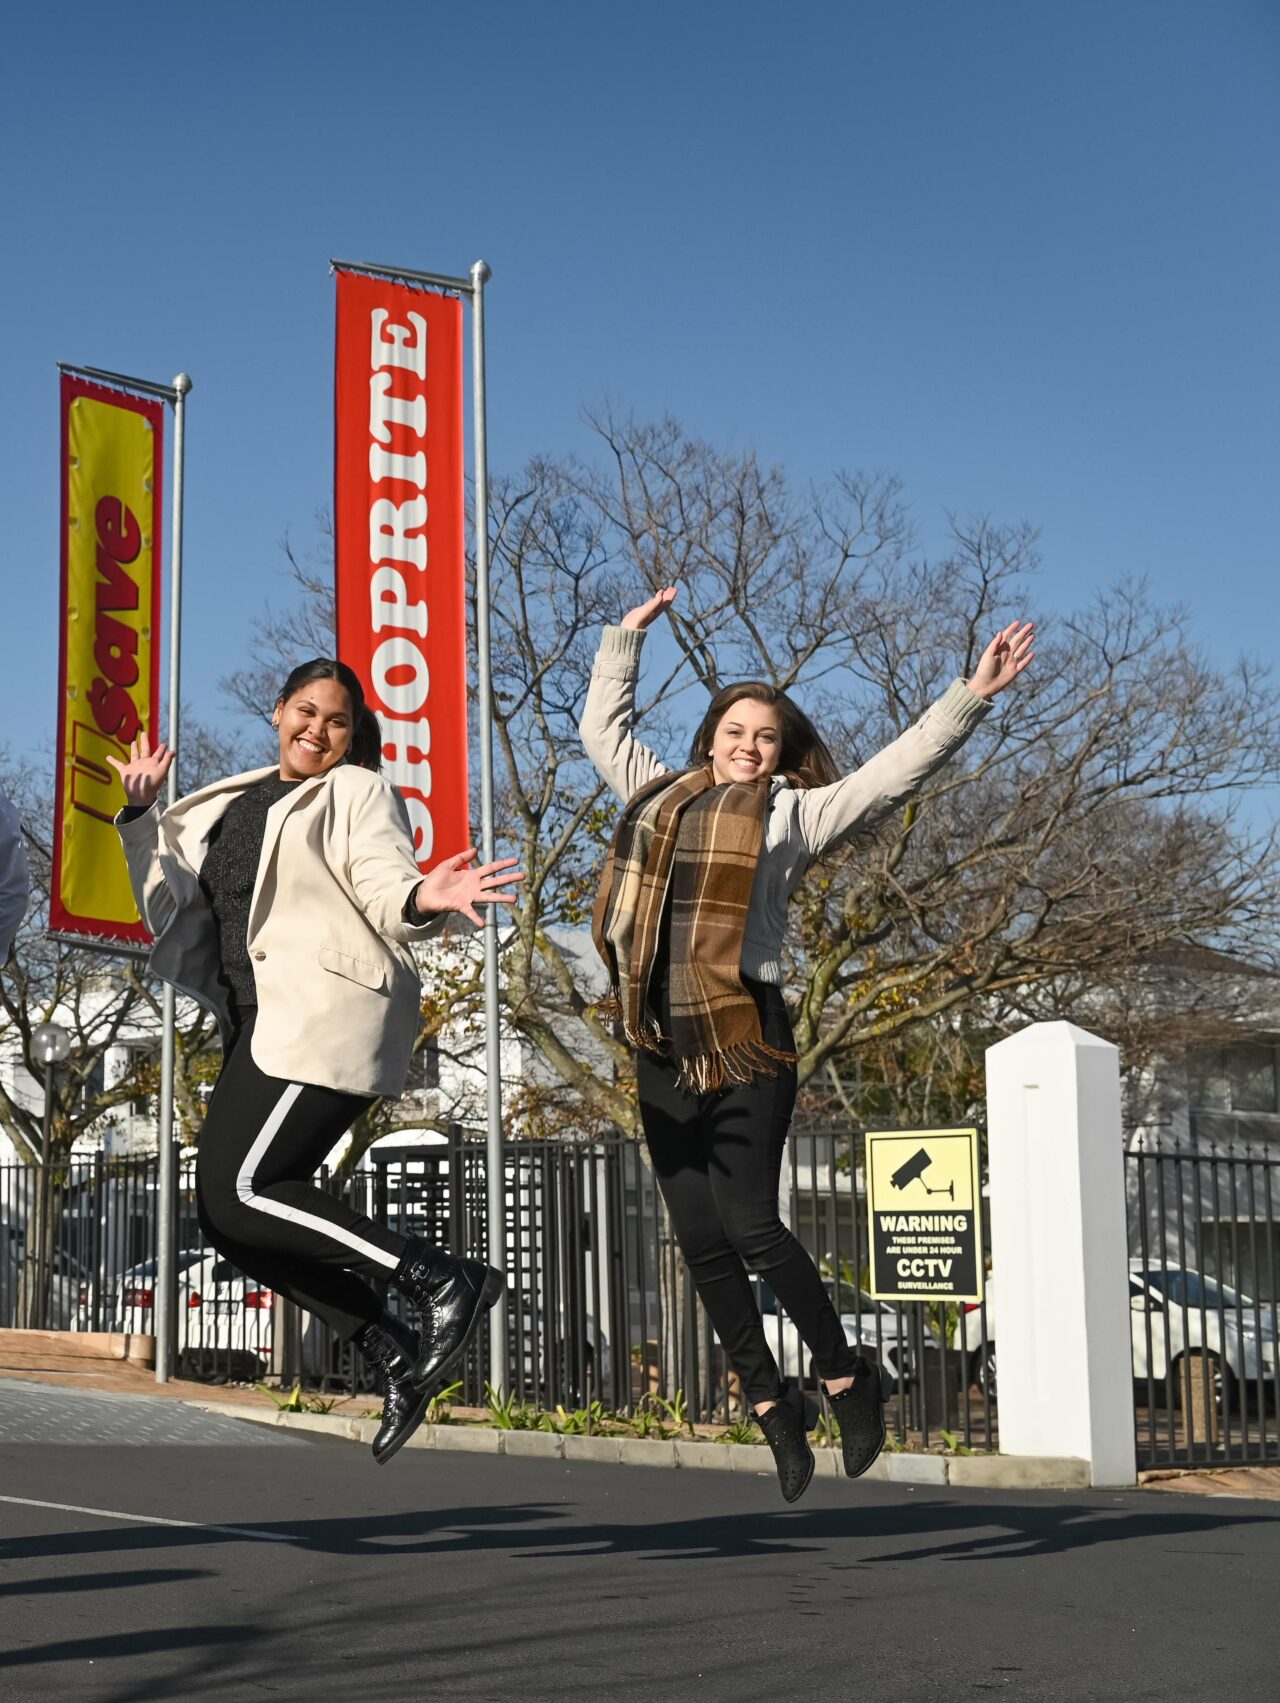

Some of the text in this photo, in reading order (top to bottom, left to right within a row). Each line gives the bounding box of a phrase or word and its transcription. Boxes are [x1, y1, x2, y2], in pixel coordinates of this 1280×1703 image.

[880, 1215, 968, 1232] WARNING
[892, 1236, 955, 1244] THESE PREMISES
[886, 1246, 962, 1254] ARE UNDER 24 HOUR
[896, 1258, 952, 1277] CCTV
[897, 1281, 954, 1290] SURVEILLANCE
